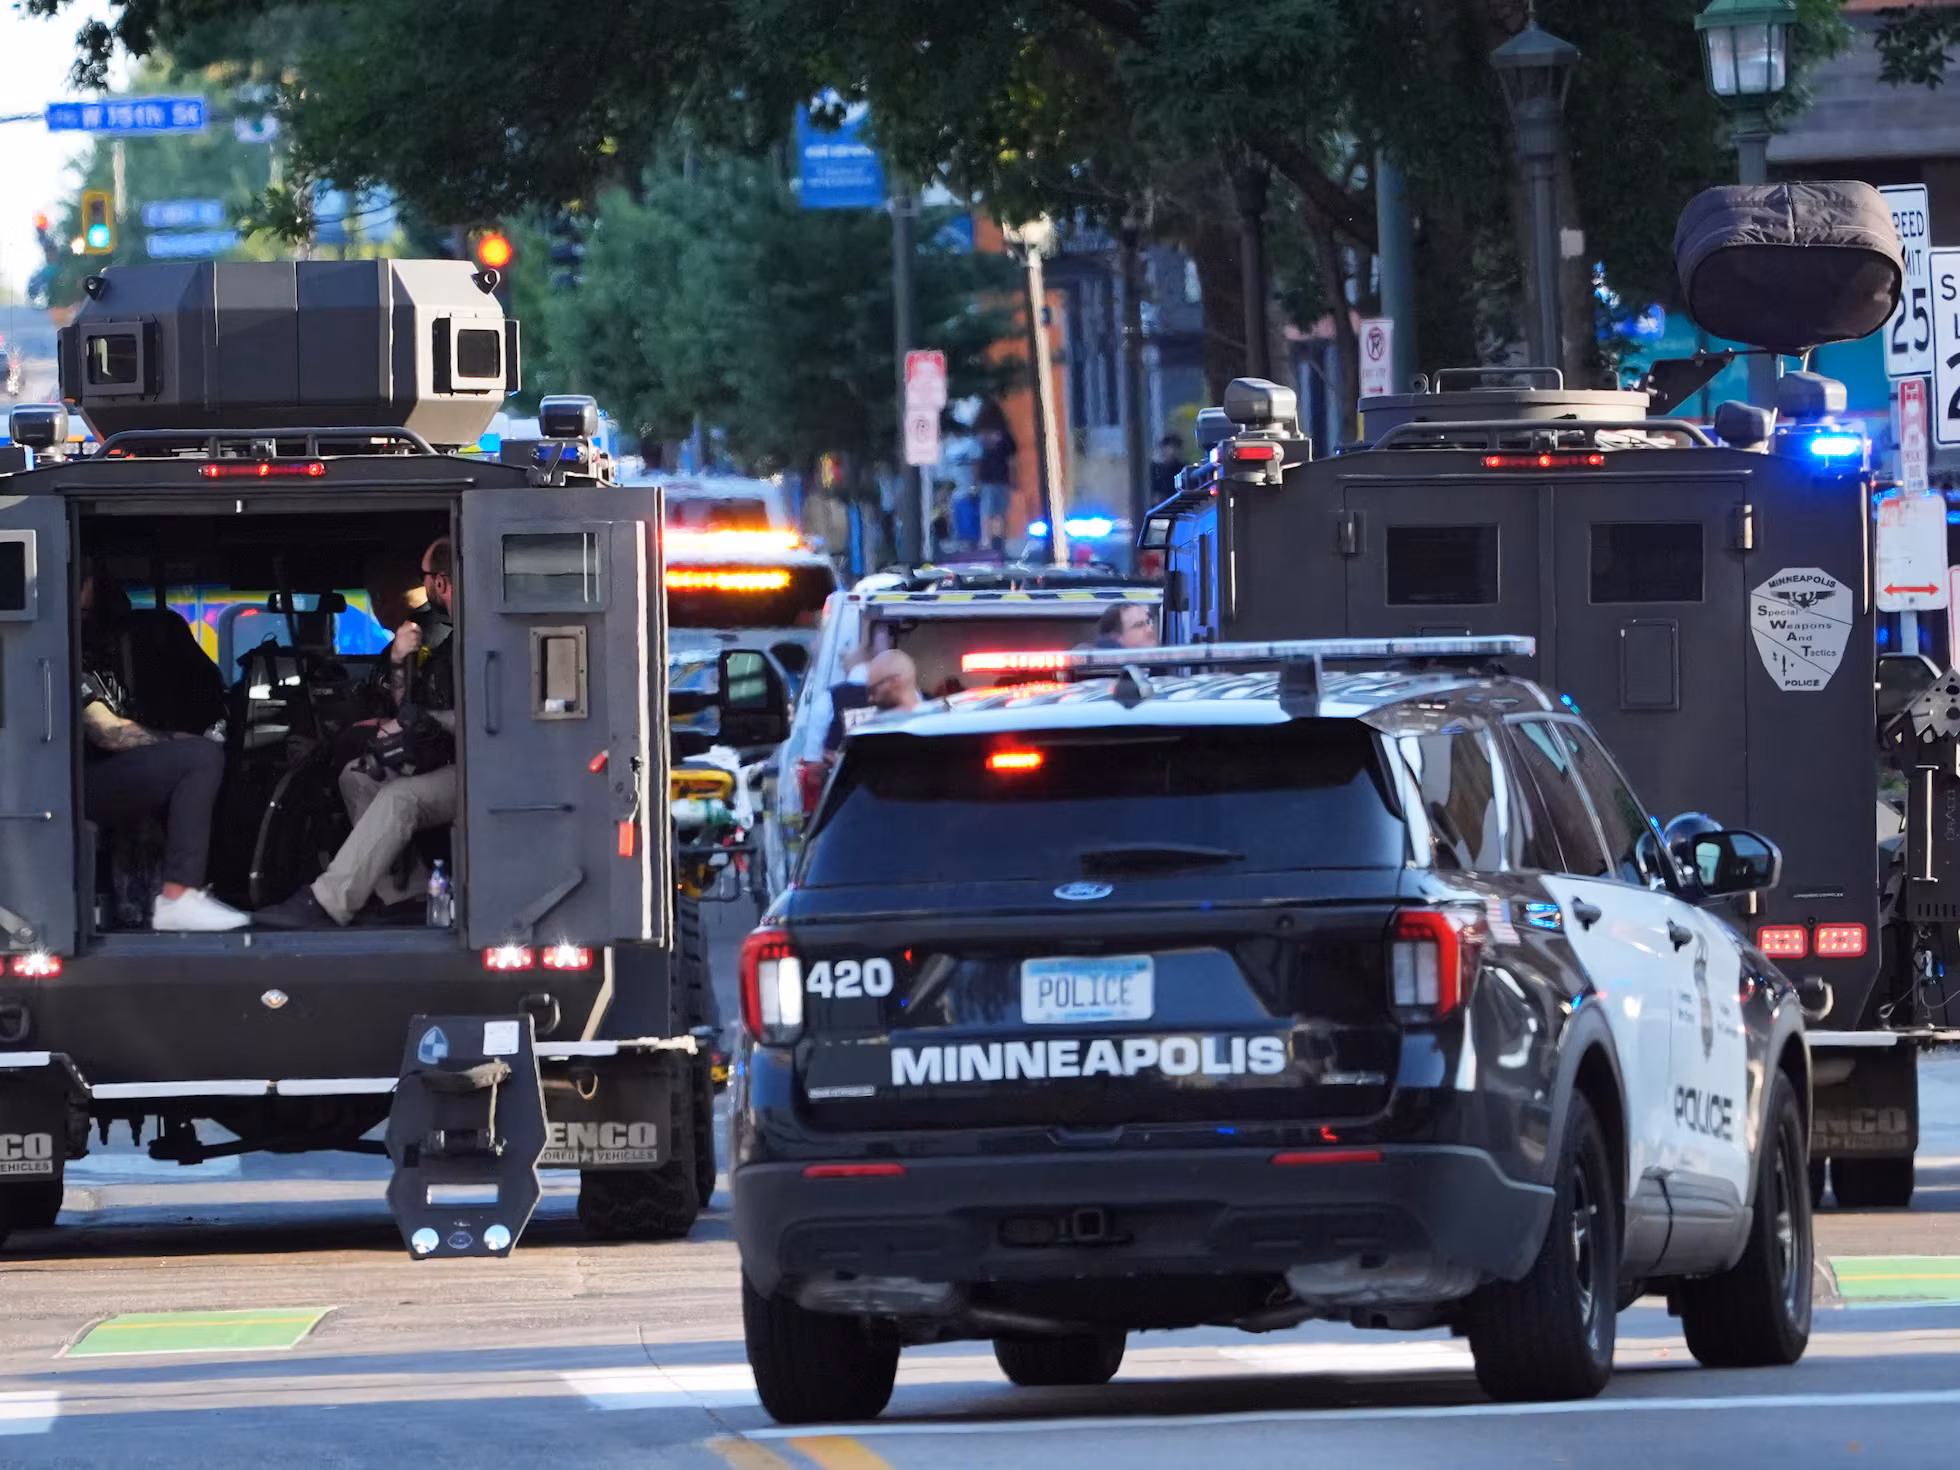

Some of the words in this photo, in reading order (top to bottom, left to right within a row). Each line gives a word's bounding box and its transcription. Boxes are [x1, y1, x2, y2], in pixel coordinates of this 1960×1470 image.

[1892, 210, 1925, 238] PEED
[1904, 249, 1922, 276] MIT
[1891, 287, 1930, 355] 25
[1768, 574, 1837, 589] MINNEAPOLIS
[1757, 604, 1799, 617] Special
[1769, 620, 1832, 631] Weapons
[1786, 632, 1813, 642] And
[1801, 645, 1837, 658] Tactics
[1784, 679, 1820, 687] POLICE
[806, 957, 894, 1000] 420
[1038, 974, 1134, 1009] POLICE
[890, 1035, 1287, 1087] MINNEAPOLIS
[1675, 1084, 1733, 1142] POLICE
[1814, 1108, 1907, 1134] NCO
[0, 1132, 53, 1161] CO
[546, 1121, 657, 1149] ENCO
[0, 1162, 49, 1172] EHICLES
[544, 1150, 576, 1161] ORED
[596, 1149, 656, 1161] VEHICLES
